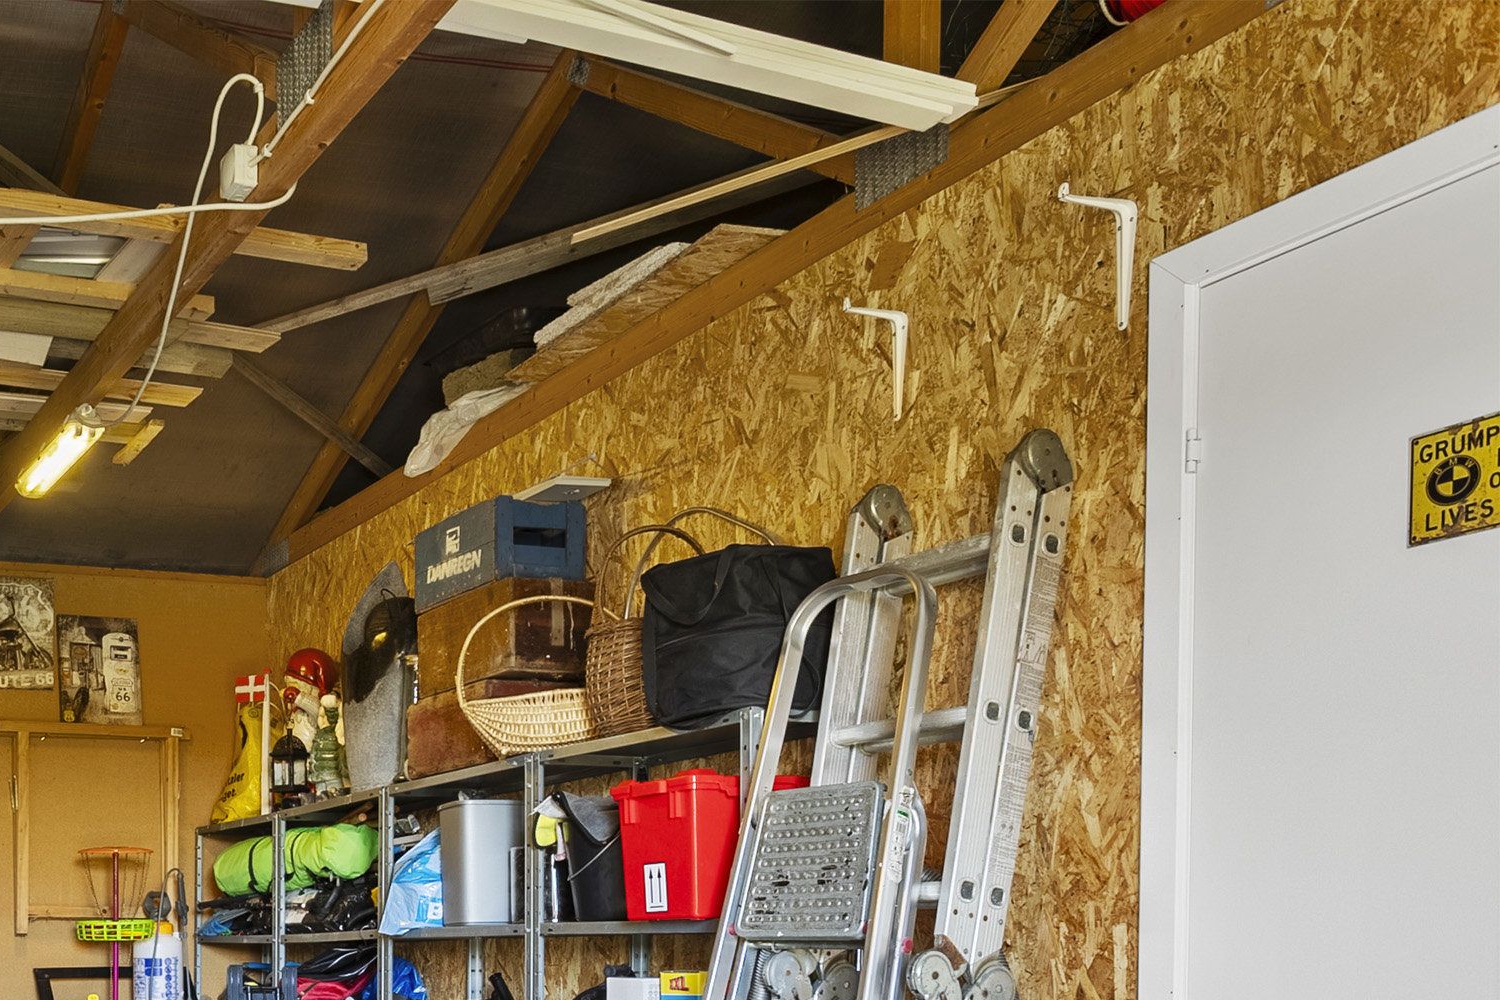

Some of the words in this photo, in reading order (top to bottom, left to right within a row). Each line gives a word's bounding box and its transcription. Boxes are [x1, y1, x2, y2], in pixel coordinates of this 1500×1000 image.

[1425, 499, 1494, 532] LIVES
[35, 673, 54, 686] 66
[115, 691, 131, 702] 66
[669, 976, 689, 991] XXL
